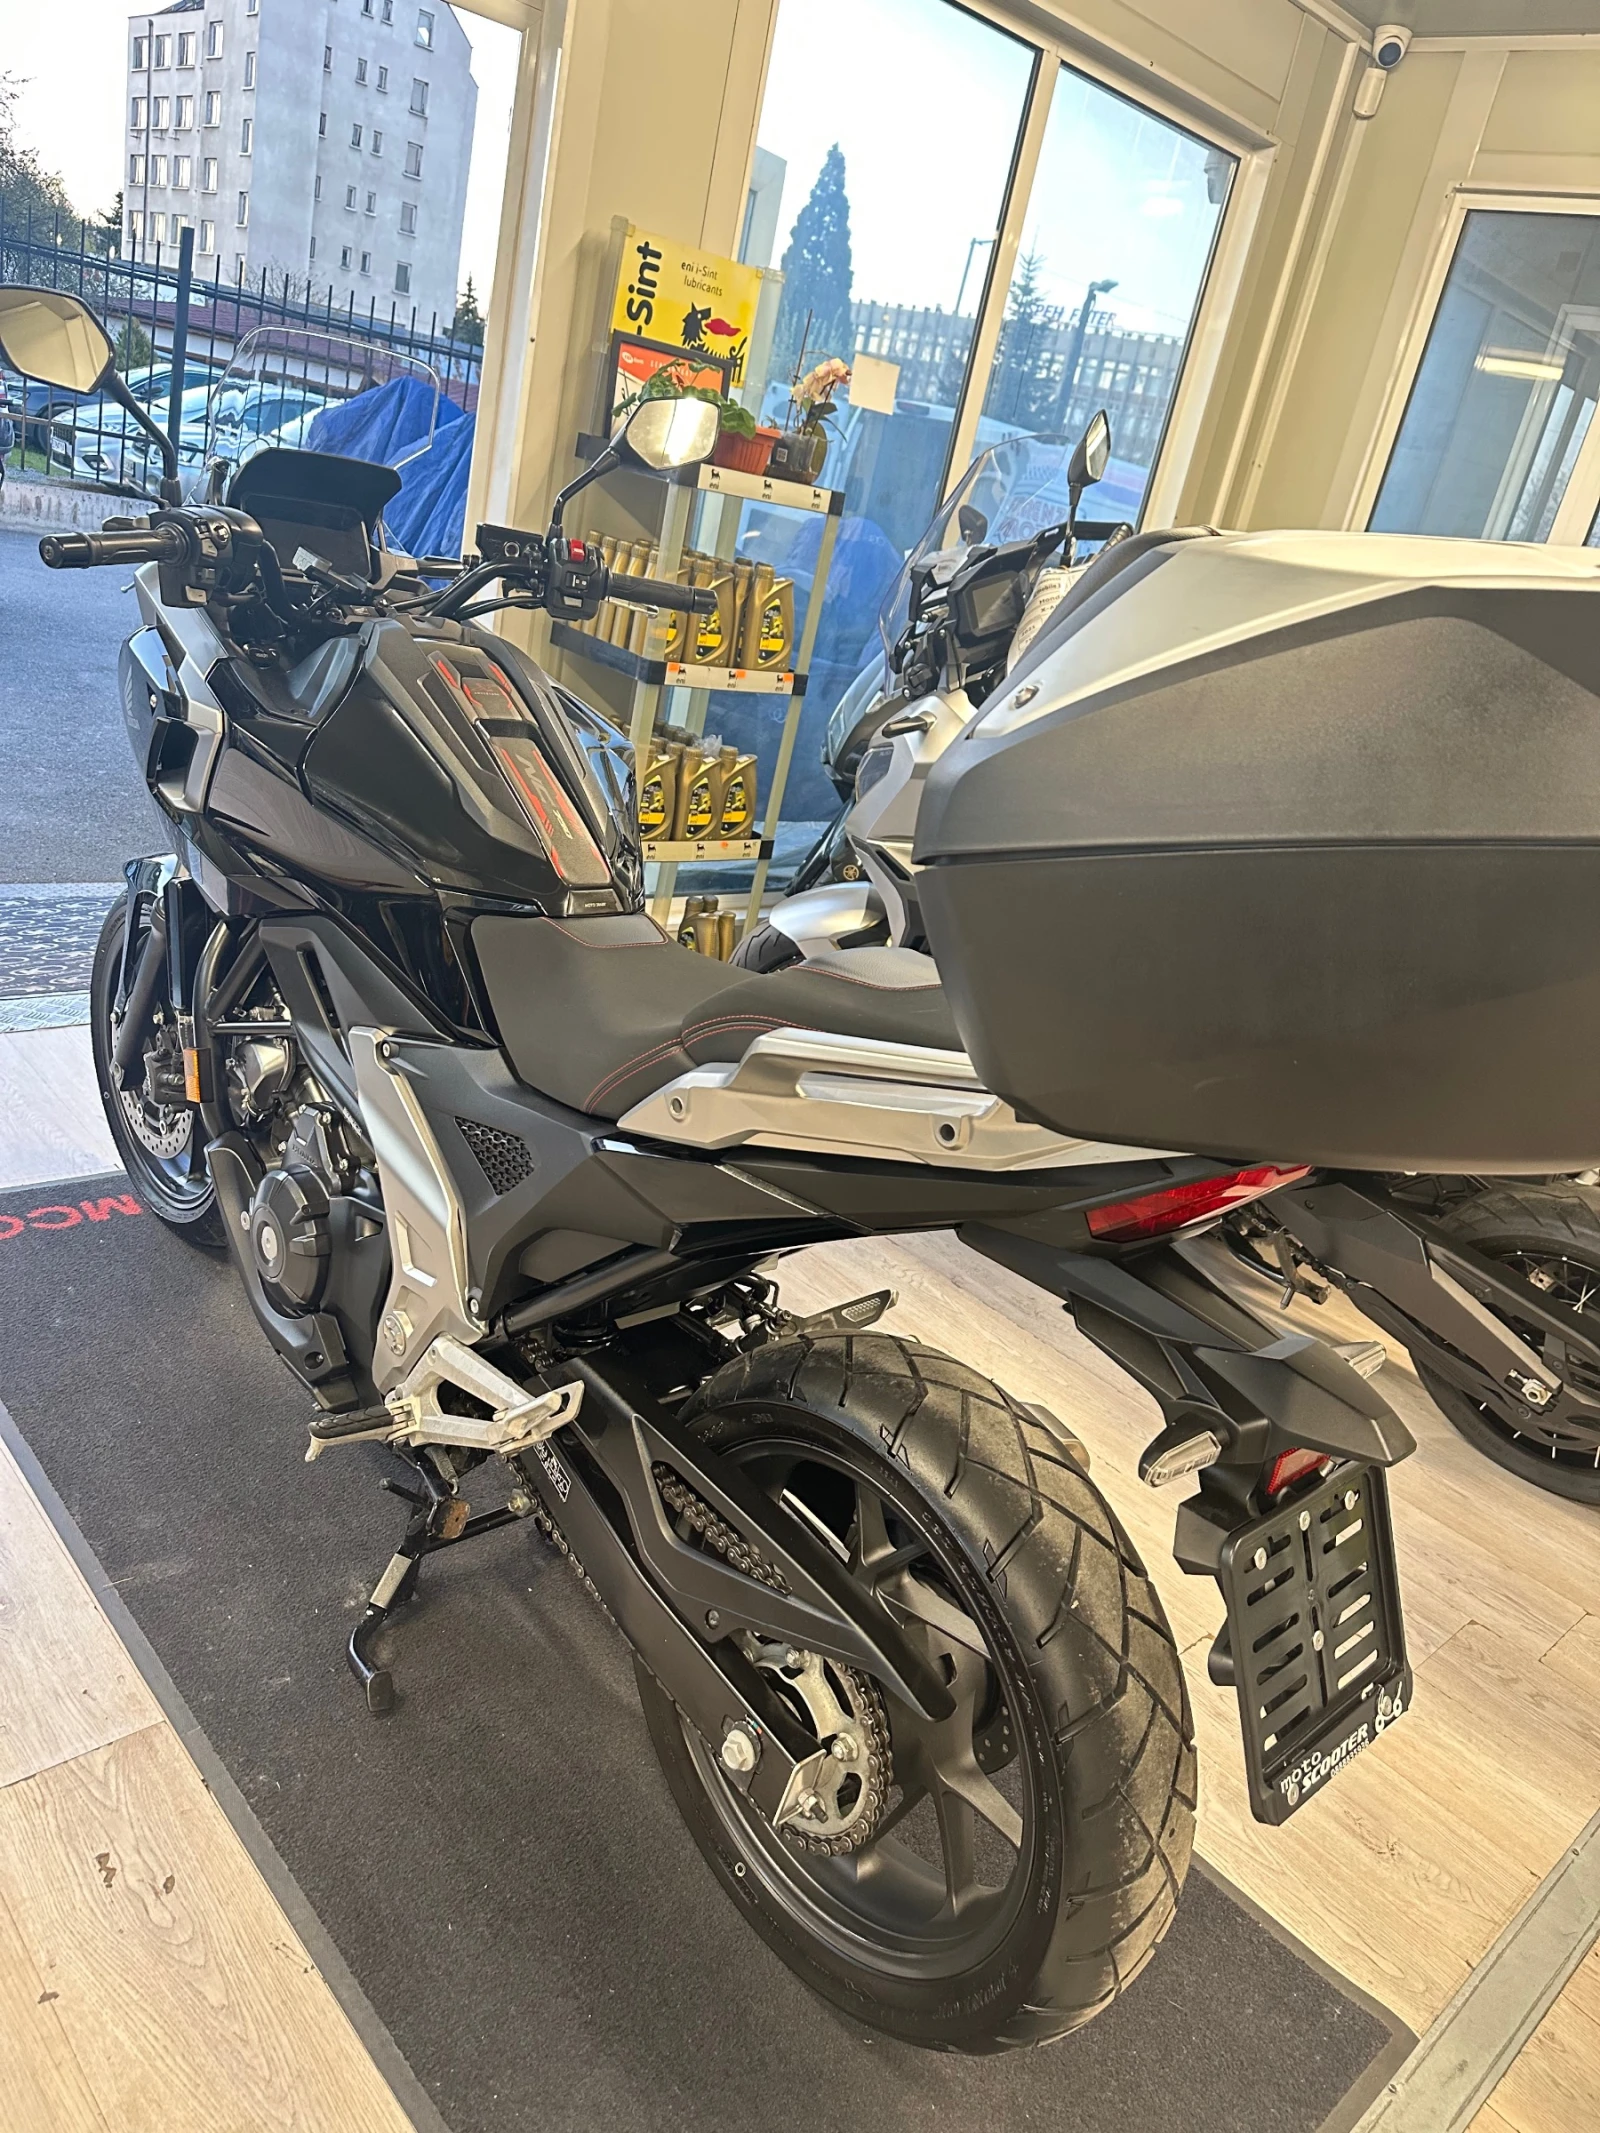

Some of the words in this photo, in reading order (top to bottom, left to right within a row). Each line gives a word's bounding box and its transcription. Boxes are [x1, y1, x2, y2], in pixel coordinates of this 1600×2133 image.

[681, 261, 694, 272] eni
[683, 275, 723, 297] lubricants
[709, 482, 720, 490] eni
[761, 492, 772, 500] eni
[1301, 1722, 1368, 1794] SCOOTER
